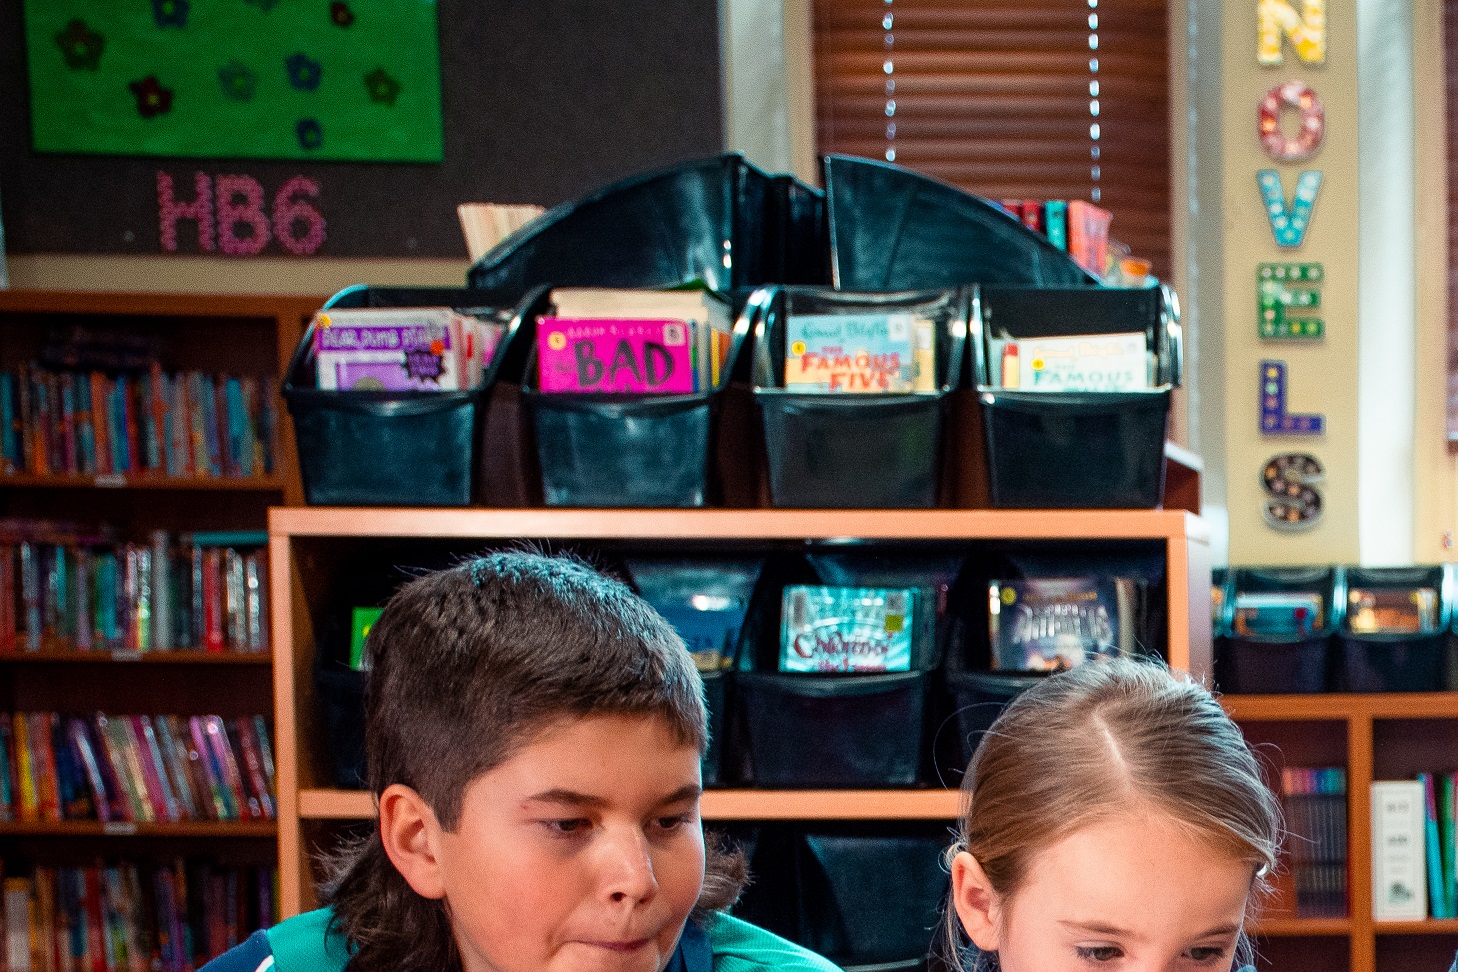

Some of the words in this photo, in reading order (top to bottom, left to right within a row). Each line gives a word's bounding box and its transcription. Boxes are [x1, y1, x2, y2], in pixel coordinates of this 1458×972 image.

[157, 171, 327, 255] HB6
[1257, 0, 1326, 531] NOVELS
[574, 339, 674, 387] BAD
[801, 352, 900, 373] FAMOUS
[829, 370, 889, 392] FIVE
